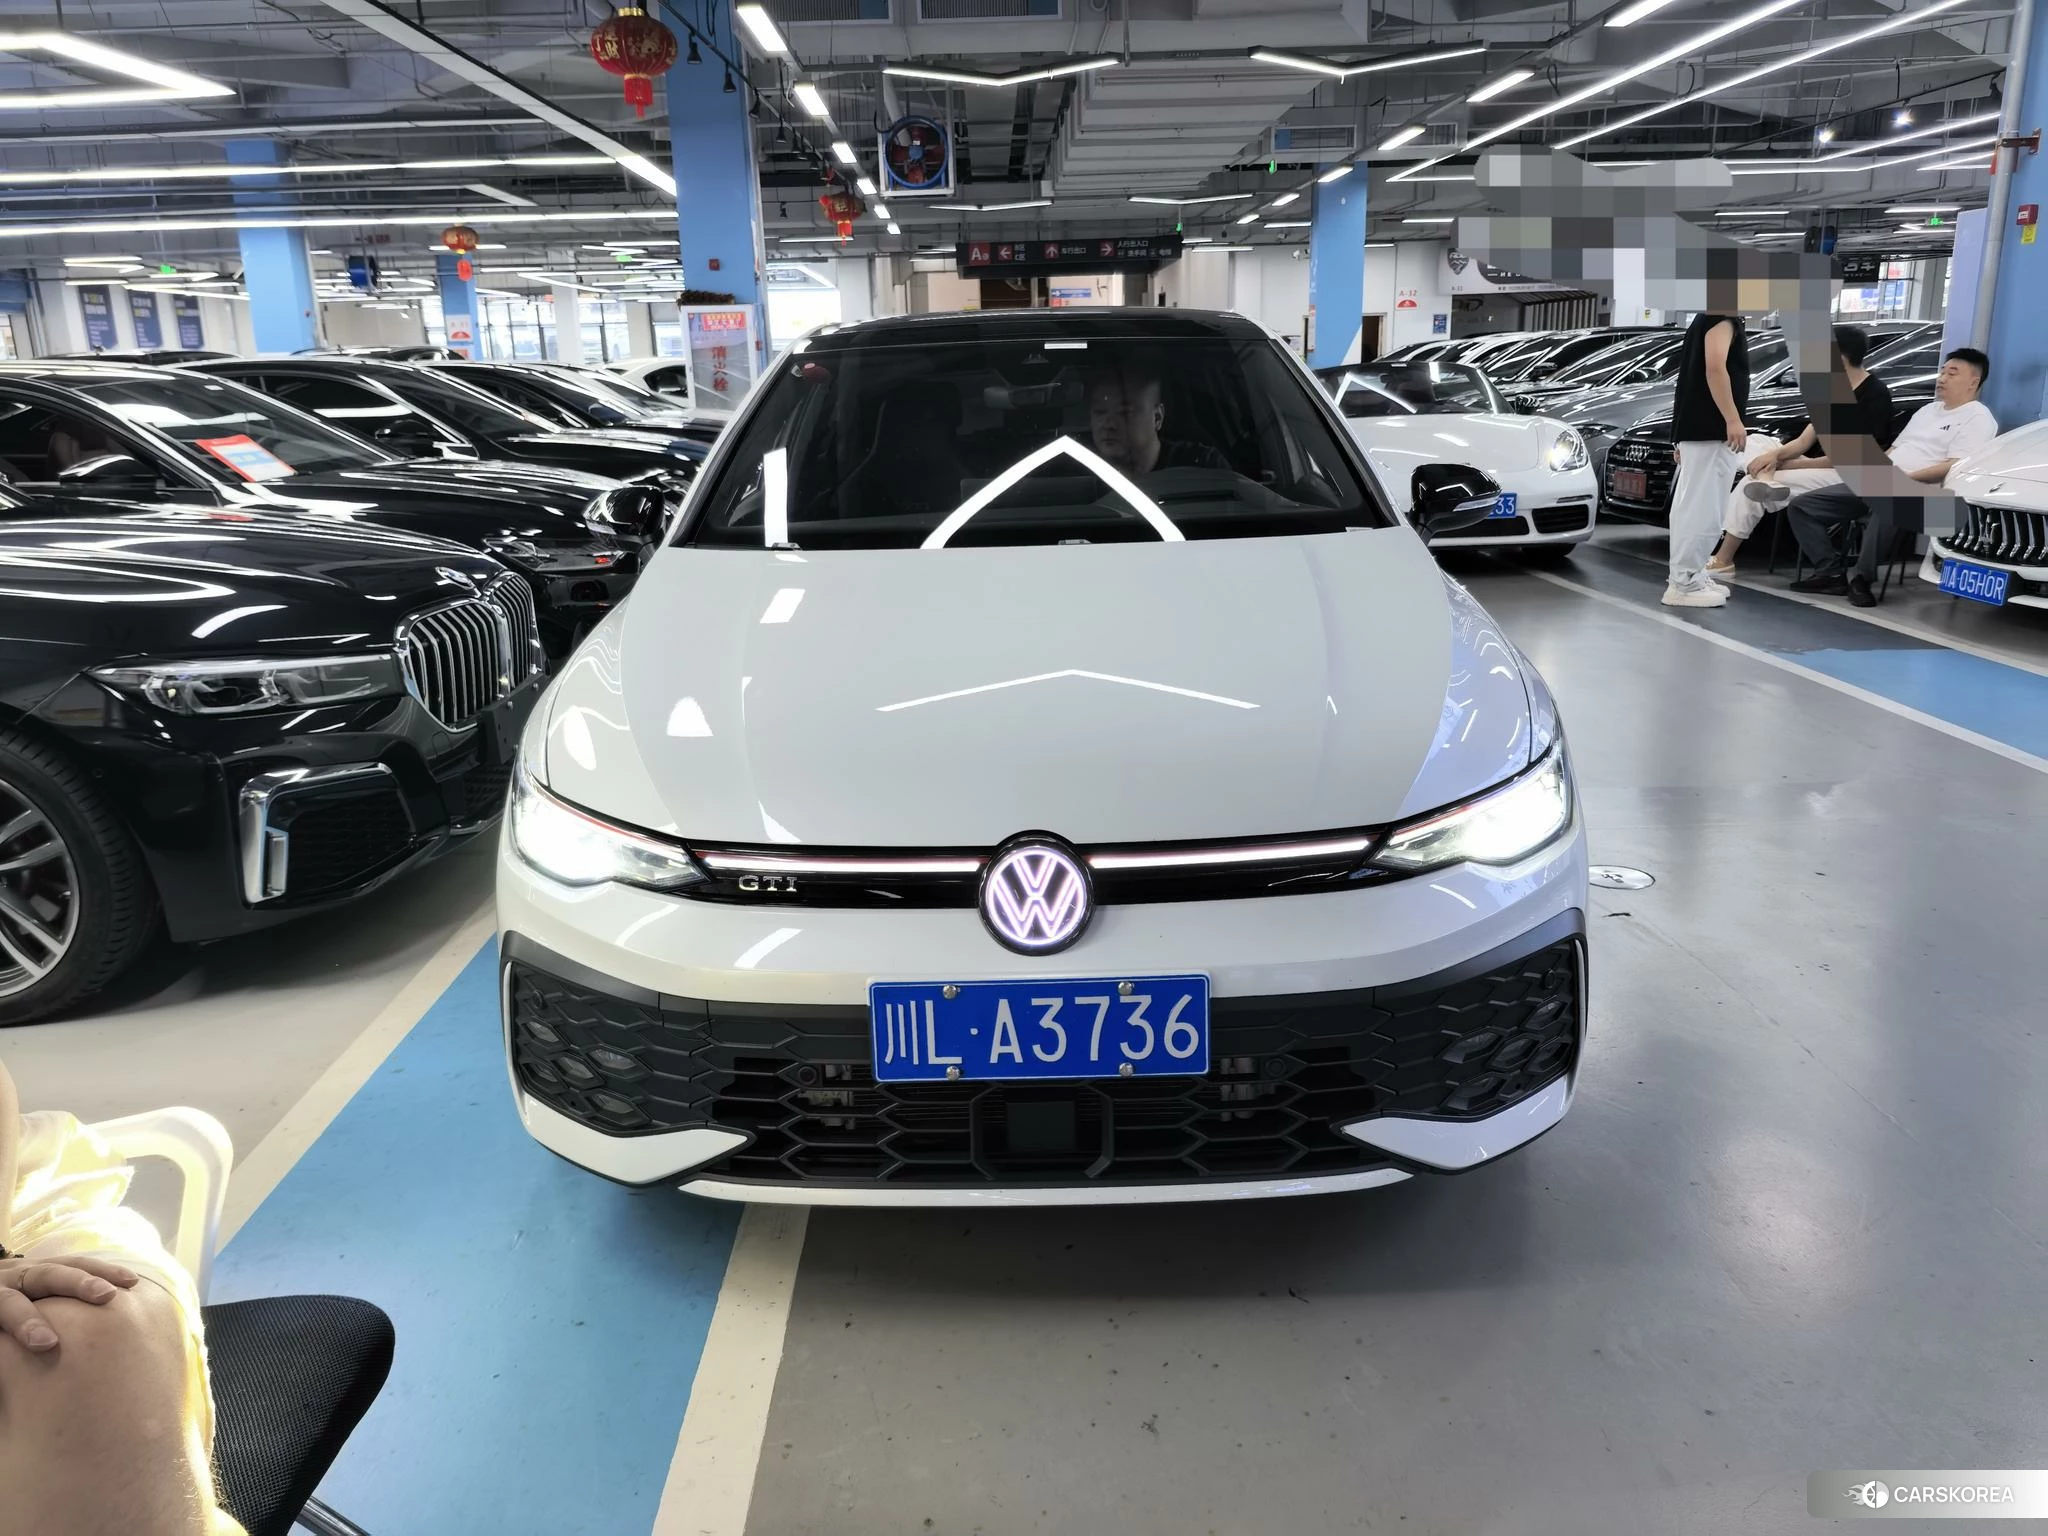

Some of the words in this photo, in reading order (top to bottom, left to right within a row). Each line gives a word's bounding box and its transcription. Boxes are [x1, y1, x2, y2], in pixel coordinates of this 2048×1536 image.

[712, 346, 728, 391] 消火栓
[1490, 497, 1516, 516] 33
[738, 875, 798, 892] GTI
